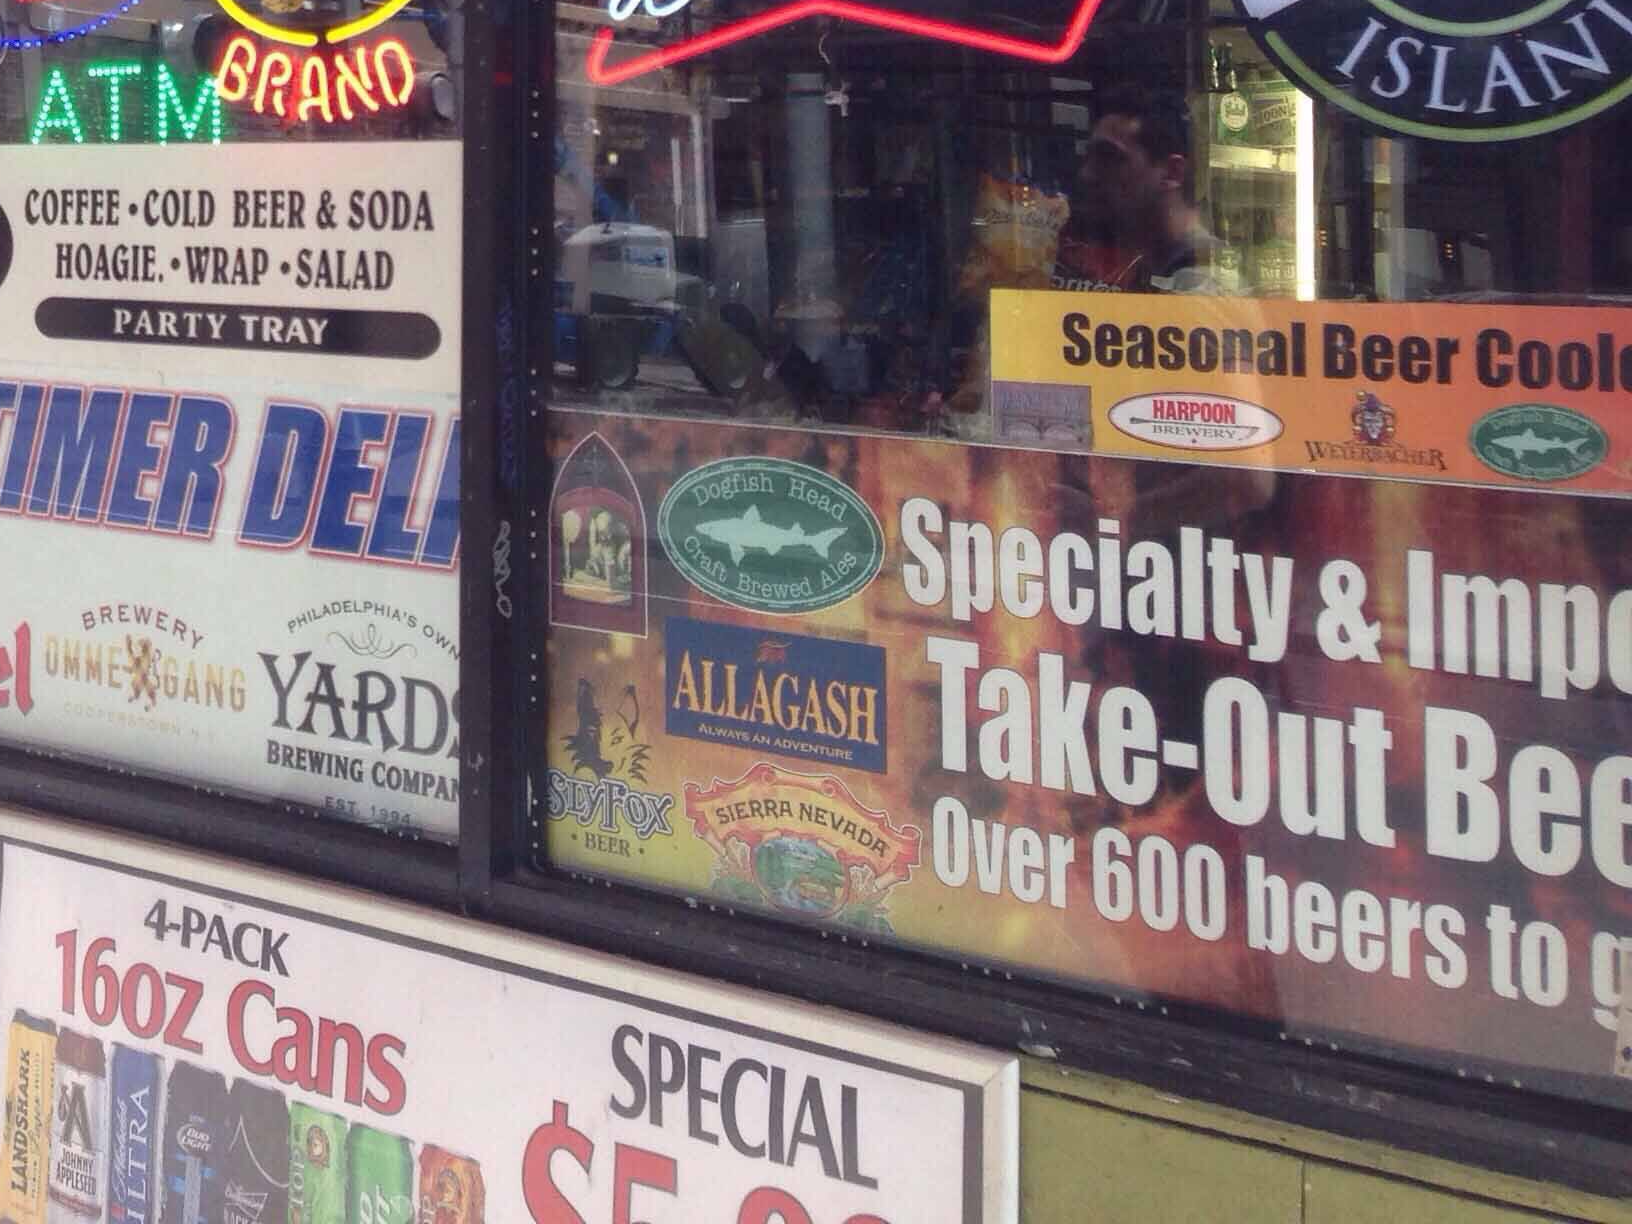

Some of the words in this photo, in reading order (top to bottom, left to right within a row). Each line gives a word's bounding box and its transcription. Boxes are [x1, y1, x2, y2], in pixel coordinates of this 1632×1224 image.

[29, 63, 226, 145] ATM
[215, 37, 416, 124] BRAND
[25, 189, 121, 226] COFFEE
[144, 191, 216, 228] COLD
[233, 193, 306, 230] BEER
[316, 195, 338, 230] &
[347, 190, 435, 232] SODA
[185, 247, 269, 286] WRAP
[295, 249, 395, 290] SALAD
[114, 309, 227, 340] PARTY
[239, 315, 329, 346] TRAY
[1061, 312, 1307, 379] Seasonal
[1323, 323, 1460, 385] Beer
[1152, 399, 1236, 424] HARPOON
[1152, 424, 1237, 441] BREWERY
[694, 470, 774, 508] Dogfish
[787, 479, 848, 523] Head
[683, 535, 726, 583] Craft
[737, 572, 814, 600] Brewed
[821, 550, 857, 590] Ales
[900, 497, 1294, 663] Specialty
[1315, 558, 1382, 664] &
[82, 604, 206, 650] BREWERY
[287, 600, 417, 634] PHILADELPHIA'S
[673, 649, 880, 745] ALLAGASH
[266, 740, 364, 784] BREWING
[698, 721, 750, 745] ALWAYS
[753, 733, 771, 746] AN
[774, 737, 854, 762] ADVENTURE
[926, 636, 1397, 850] Take-Out
[584, 831, 631, 858] BEER
[716, 800, 795, 826] SIERRA
[799, 803, 889, 857] NEVADA
[932, 795, 1075, 909] Over
[1091, 826, 1228, 943] 600
[1246, 856, 1468, 989] beers
[1487, 904, 1568, 1007] to
[144, 899, 290, 977] 4-PACK
[226, 979, 407, 1116] Cans
[11, 1048, 30, 1195] LANDSHARK
[609, 1024, 878, 1190] SPECIAL
[56, 1162, 97, 1196] APPLESEED
[61, 1148, 94, 1174] JOHNNY
